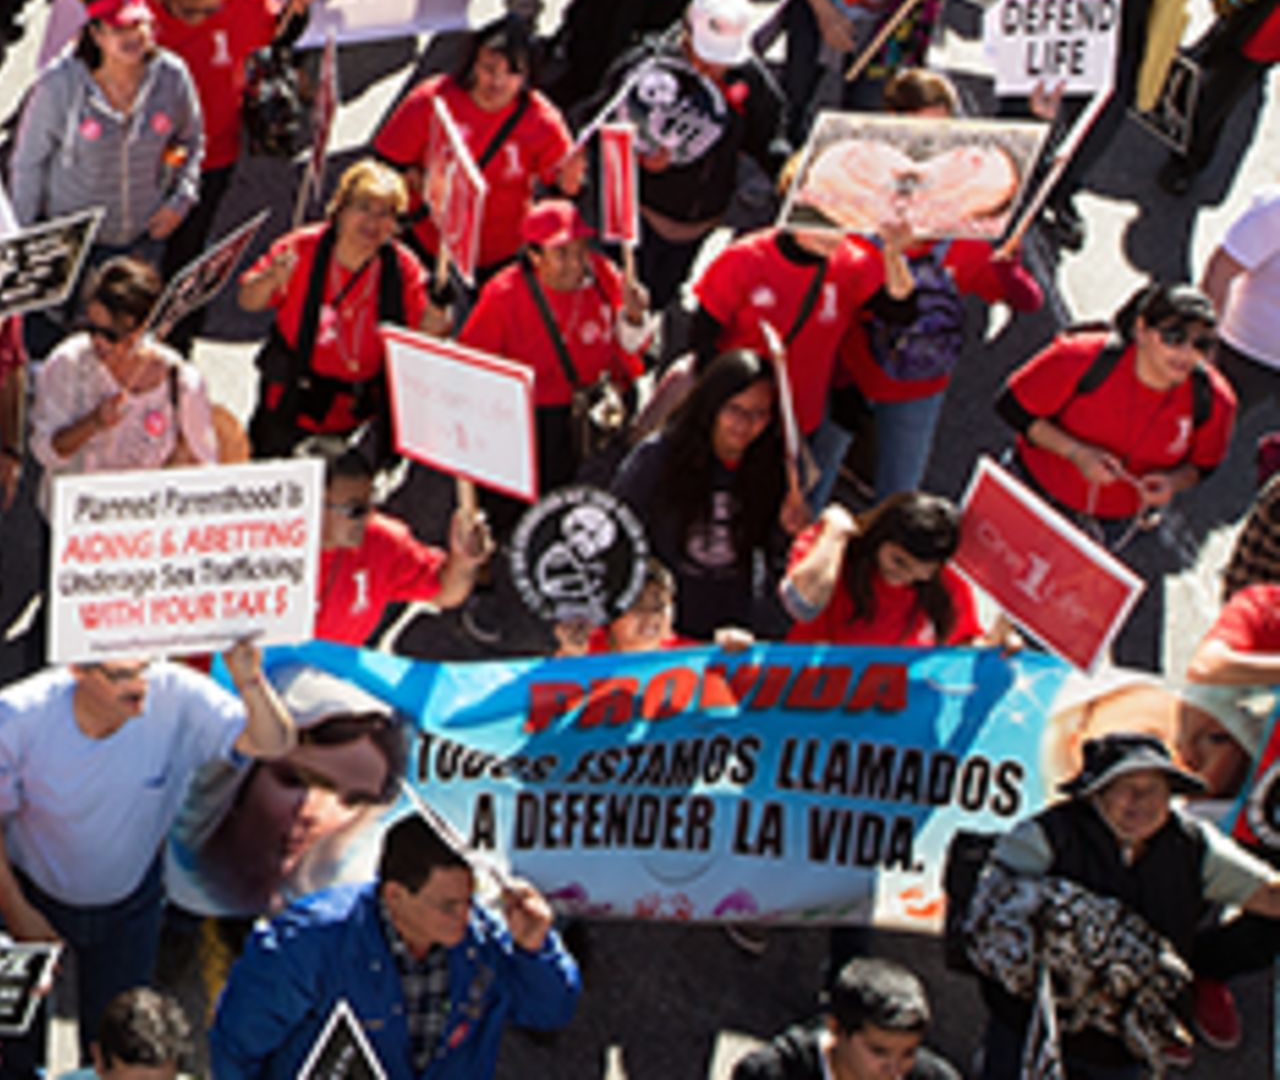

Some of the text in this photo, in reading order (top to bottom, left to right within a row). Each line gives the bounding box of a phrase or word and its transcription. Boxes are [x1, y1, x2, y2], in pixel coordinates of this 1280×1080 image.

[1025, 38, 1086, 76] LIFE
[73, 492, 158, 523] Planned
[162, 482, 283, 516] Parenthood
[60, 518, 307, 564] AIDING & ABETTING
[58, 557, 306, 599] Underage Sex Trafficking
[351, 571, 370, 611] 1
[79, 600, 145, 630] WITH
[150, 593, 216, 626] YOUR
[220, 588, 271, 620] TAX
[417, 734, 1026, 818] TODOS ESTAMOS LLAMADOS
[471, 789, 926, 874] A DEFENDER LA VIDA.
